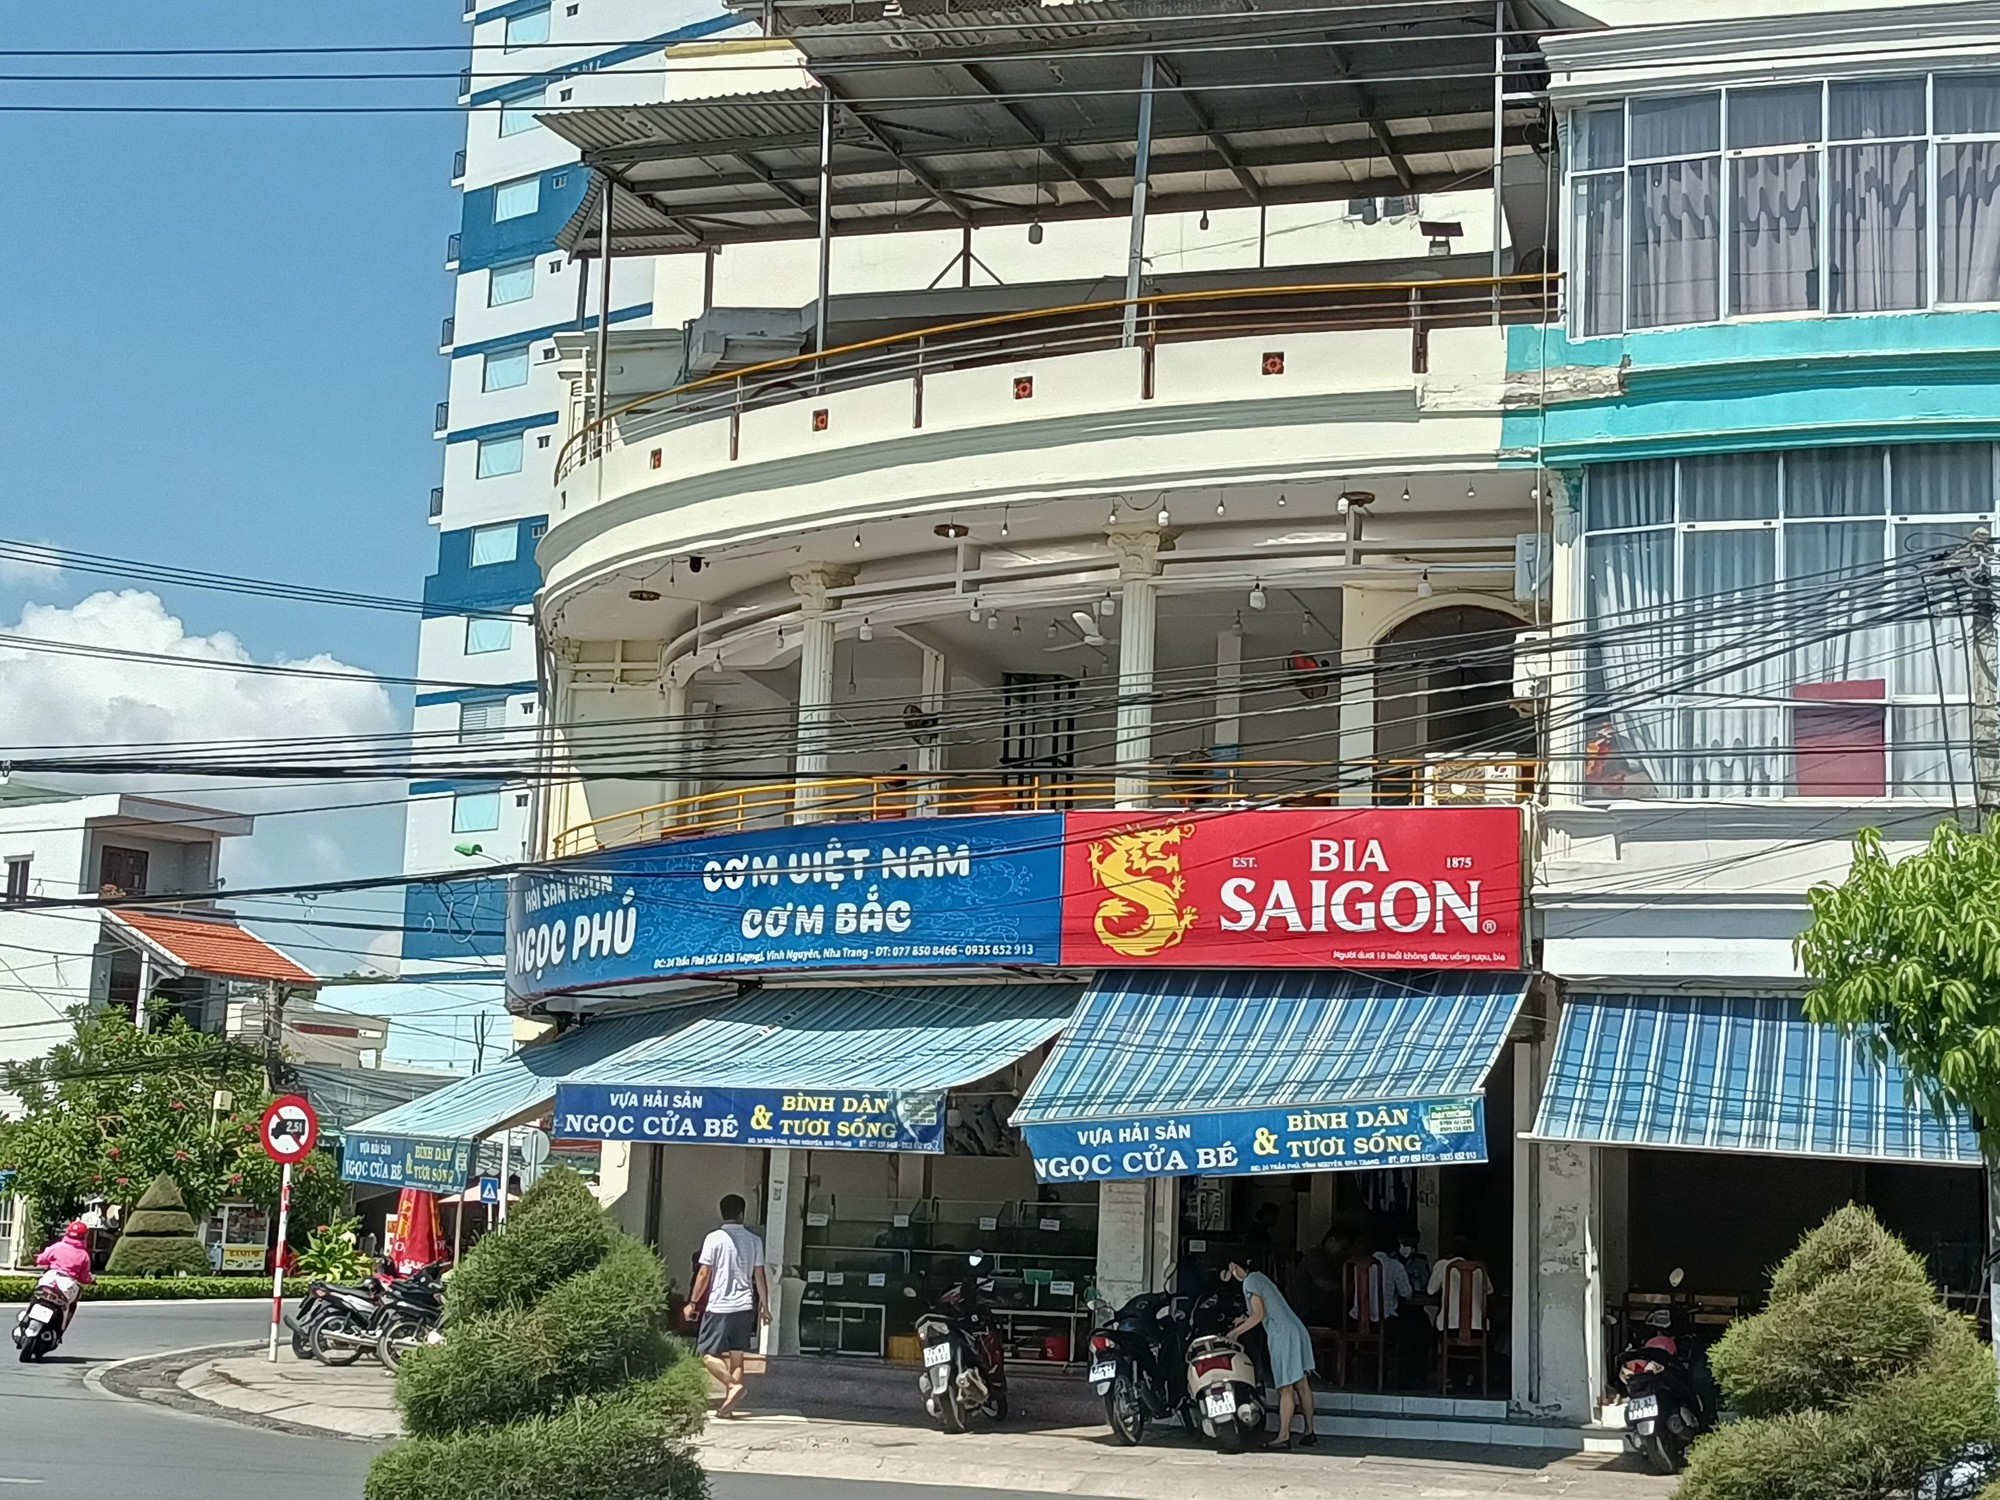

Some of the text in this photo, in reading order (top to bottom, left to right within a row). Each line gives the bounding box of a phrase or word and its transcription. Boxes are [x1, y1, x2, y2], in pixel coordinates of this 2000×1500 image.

[702, 854, 779, 892] CƠM
[882, 844, 970, 879] NAM
[1232, 857, 1258, 869] EST.
[1310, 839, 1390, 872] BIA
[1446, 857, 1472, 869] 1875
[741, 884, 912, 939] CƠM BẮC
[1219, 877, 1482, 933] SAIGON
[514, 887, 637, 980] NGỌC PHÚ
[823, 948, 841, 958] Nha
[843, 947, 868, 959] Trang
[892, 946, 911, 957] 077
[912, 945, 931, 956] 850
[932, 945, 958, 956] 8466
[965, 945, 991, 956] 0935
[992, 945, 1012, 955] 652
[1014, 944, 1034, 955] 913
[1492, 952, 1506, 961] bia
[610, 1090, 703, 1109] VỰA HẢI SẢN
[782, 1091, 836, 1112] BÌNH
[841, 1094, 889, 1114] DÂN
[563, 1110, 739, 1138] NGỌC CỬA BÉ
[750, 1104, 898, 1139] & TƯƠI SỐNG
[1286, 1110, 1349, 1132] BÌNH
[1356, 1106, 1409, 1128] DÂN
[1077, 1120, 1190, 1147] VỰA HẢI SẢN
[1253, 1127, 1423, 1158] & TƯƠI SỐNG
[1034, 1141, 1239, 1180] NGỌC CỬA BÉ
